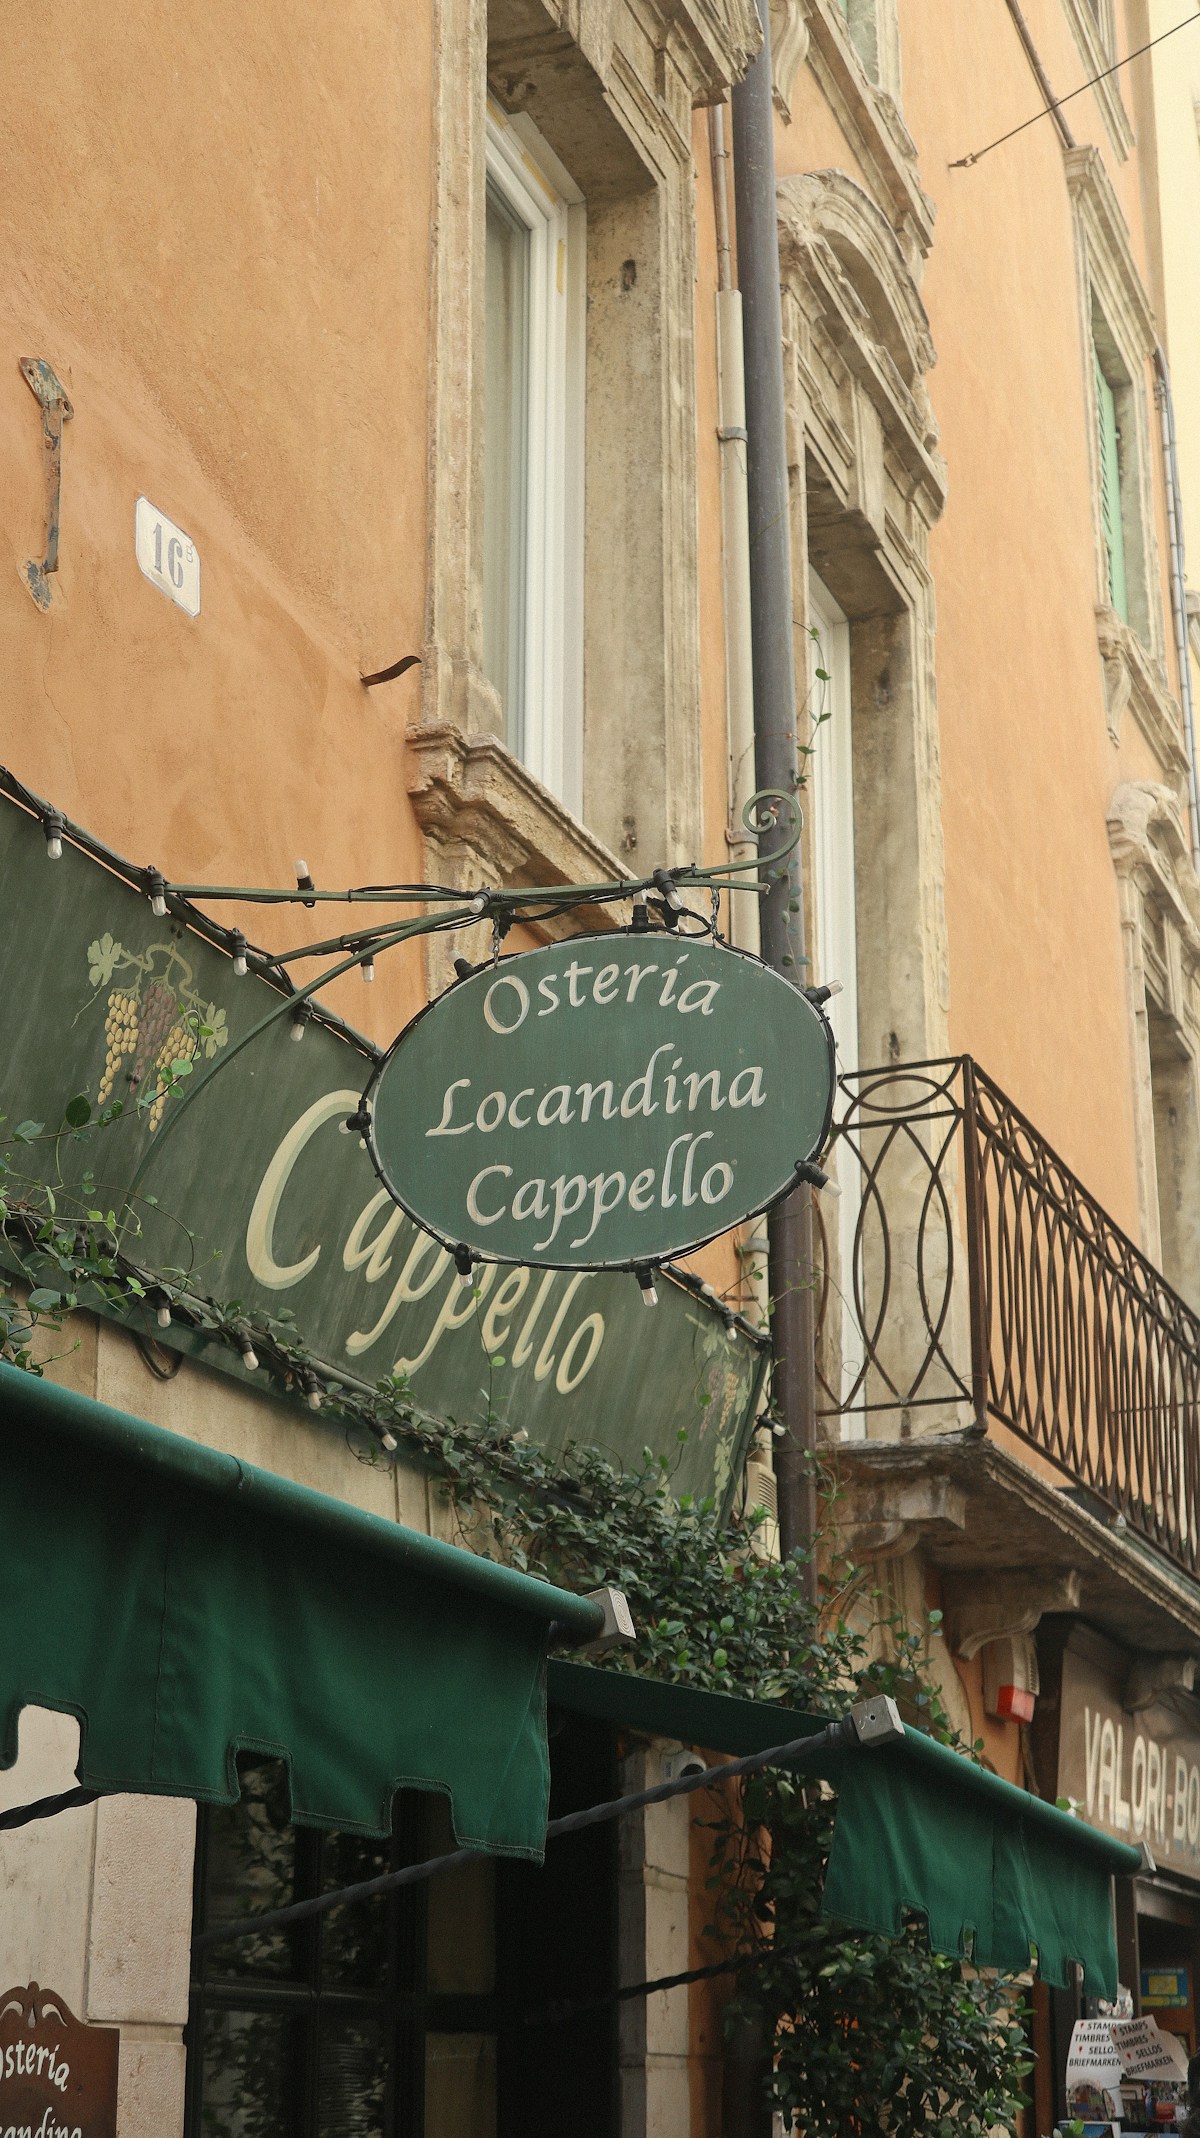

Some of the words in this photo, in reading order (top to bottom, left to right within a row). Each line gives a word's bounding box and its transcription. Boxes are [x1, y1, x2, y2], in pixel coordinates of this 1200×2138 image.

[483, 953, 721, 1034] Osteria
[425, 1043, 767, 1136] Locandina
[466, 1131, 735, 1251] Cappello
[1119, 2020, 1149, 2036] STAMPS
[1075, 2034, 1110, 2043] TIMBRES
[1116, 2034, 1149, 2051] TIMBRES
[1135, 2043, 1163, 2059] SELLOS
[0, 2039, 70, 2092] steria
[1069, 2058, 1121, 2067] BRIEFMARKEN
[1126, 2055, 1174, 2076] BRIEFMARKEN
